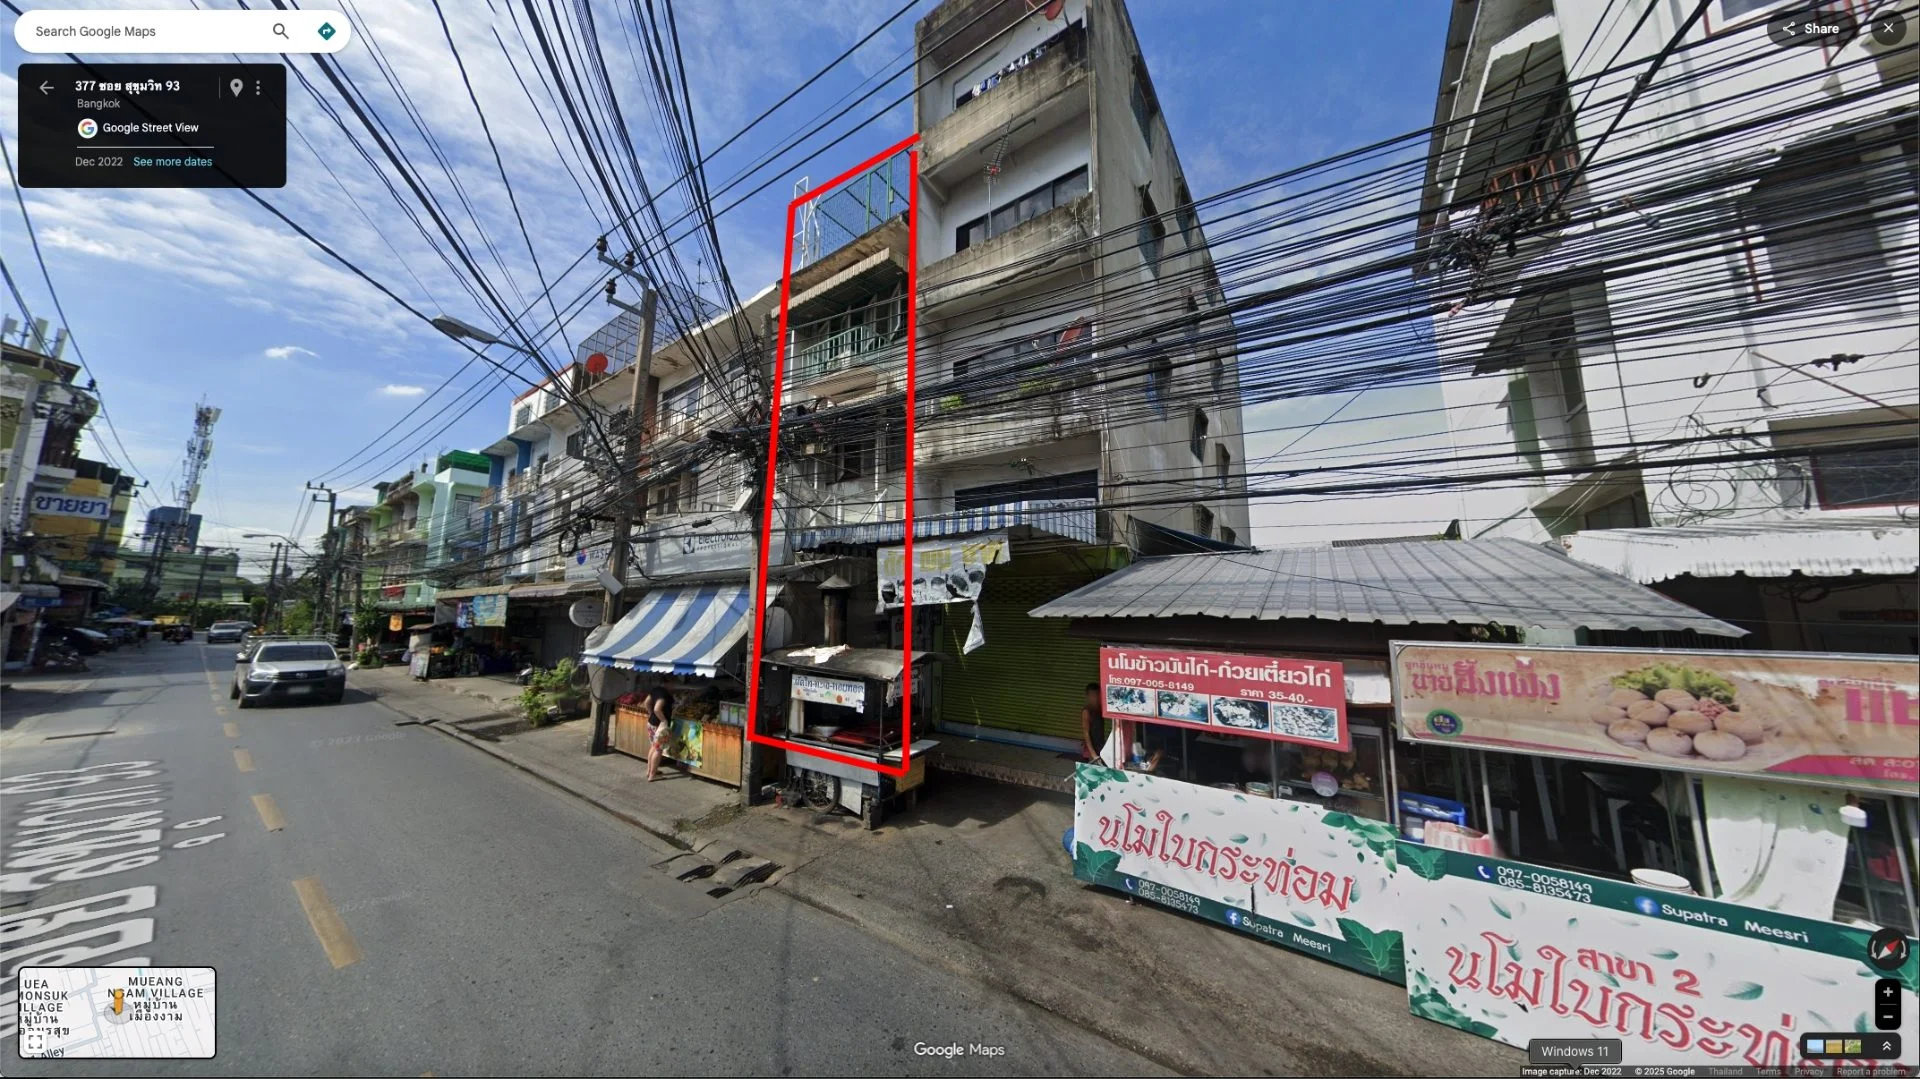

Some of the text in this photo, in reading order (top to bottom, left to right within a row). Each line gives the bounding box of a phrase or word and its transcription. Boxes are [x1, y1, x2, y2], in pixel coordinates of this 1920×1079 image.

[34, 496, 108, 515] ขายยา
[1108, 653, 1332, 688] นโมข้าวมันไก่-ก๋วยเตี๋ยวไก่
[1240, 688, 1264, 698] ราคา
[1099, 802, 1354, 912] นโมใบกระท่อม
[1497, 866, 1593, 893] 097-0058149
[1498, 875, 1592, 903] 085-8135473
[1242, 916, 1331, 954] Supatra Meesri
[1661, 903, 1809, 943] Supatra Meesri
[1577, 948, 1704, 999] สาขา 2
